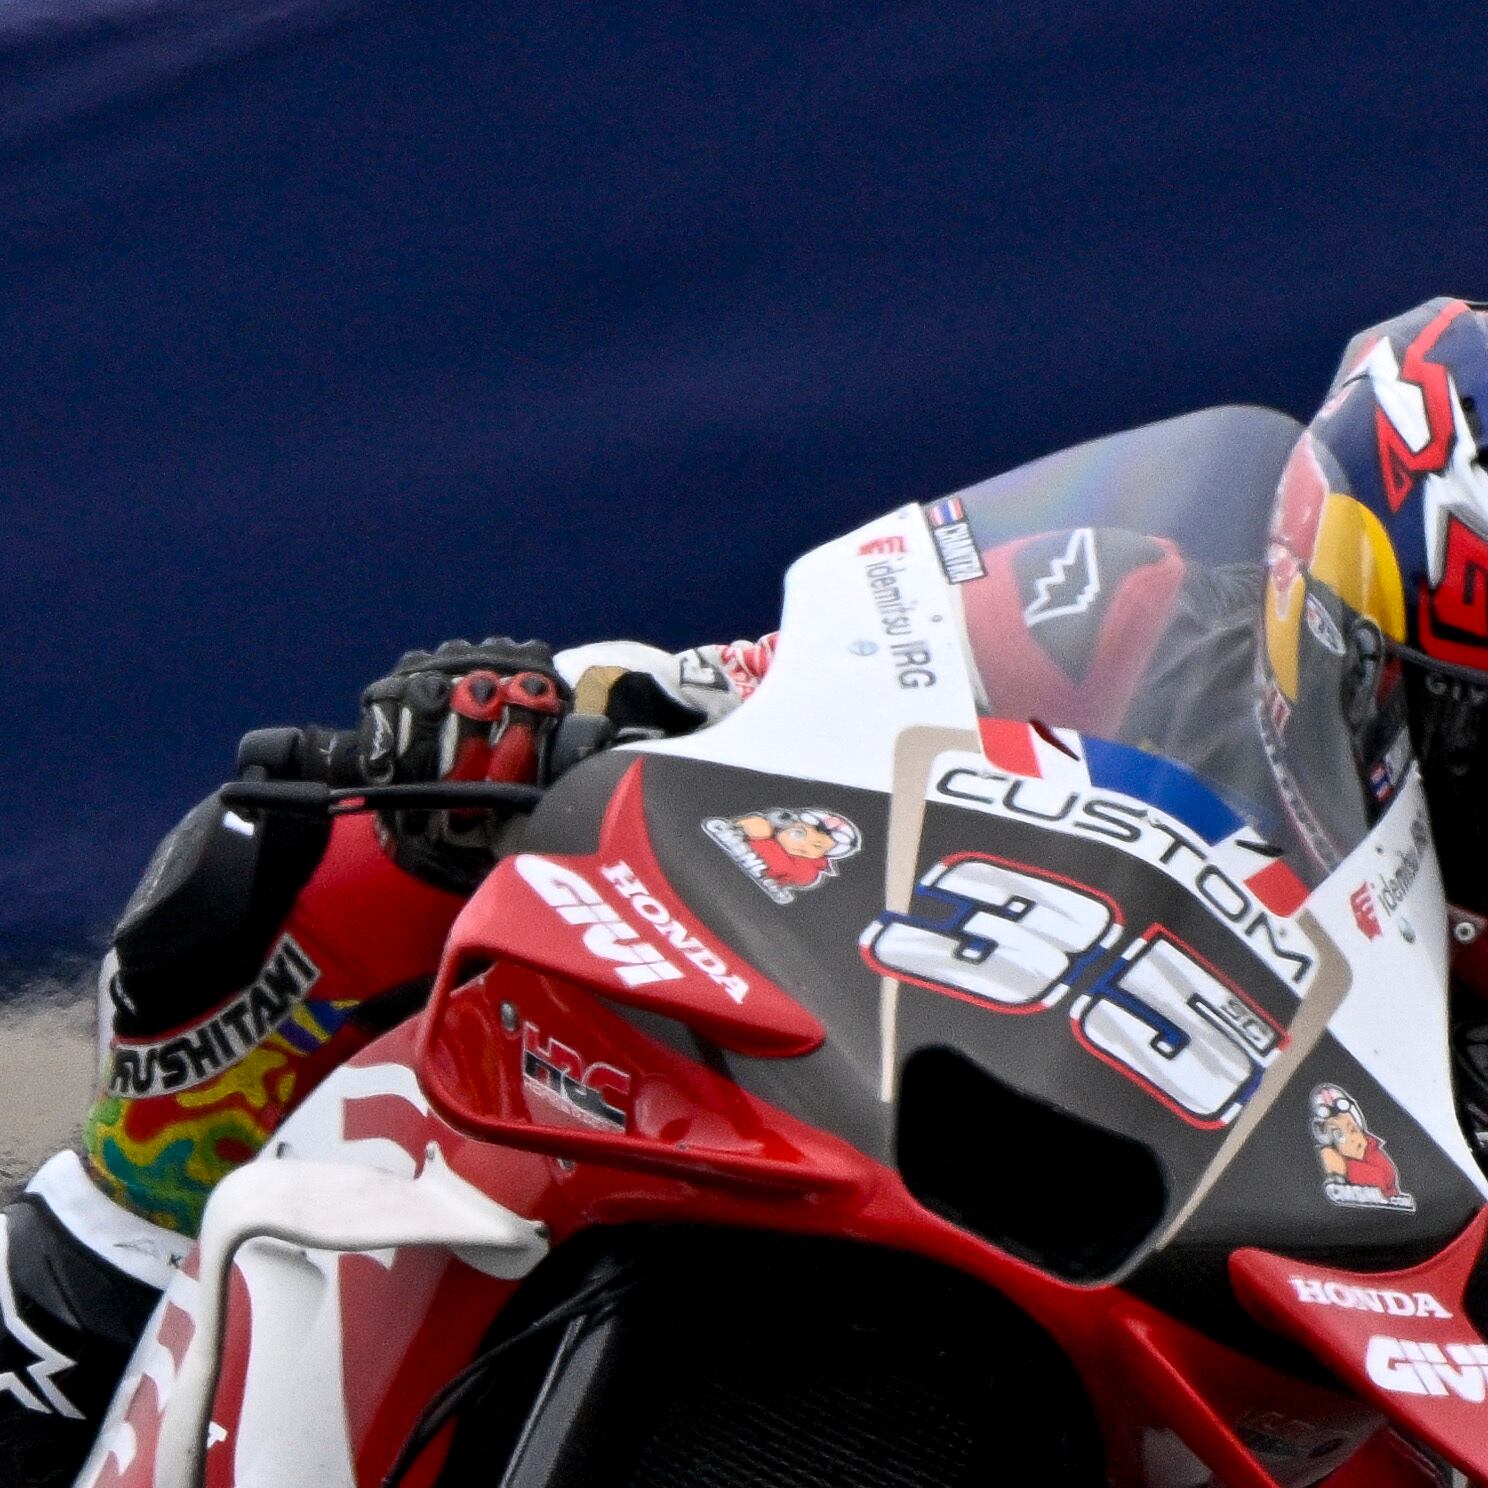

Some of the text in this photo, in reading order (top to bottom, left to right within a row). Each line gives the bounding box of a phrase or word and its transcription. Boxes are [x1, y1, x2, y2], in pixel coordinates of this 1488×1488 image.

[514, 853, 687, 988] GIVI
[601, 859, 751, 1005] HONDA
[936, 766, 1313, 984] CUSTOM
[858, 850, 1292, 1132] 35
[522, 1020, 633, 1132] HRC
[1288, 1275, 1452, 1320] HONDA
